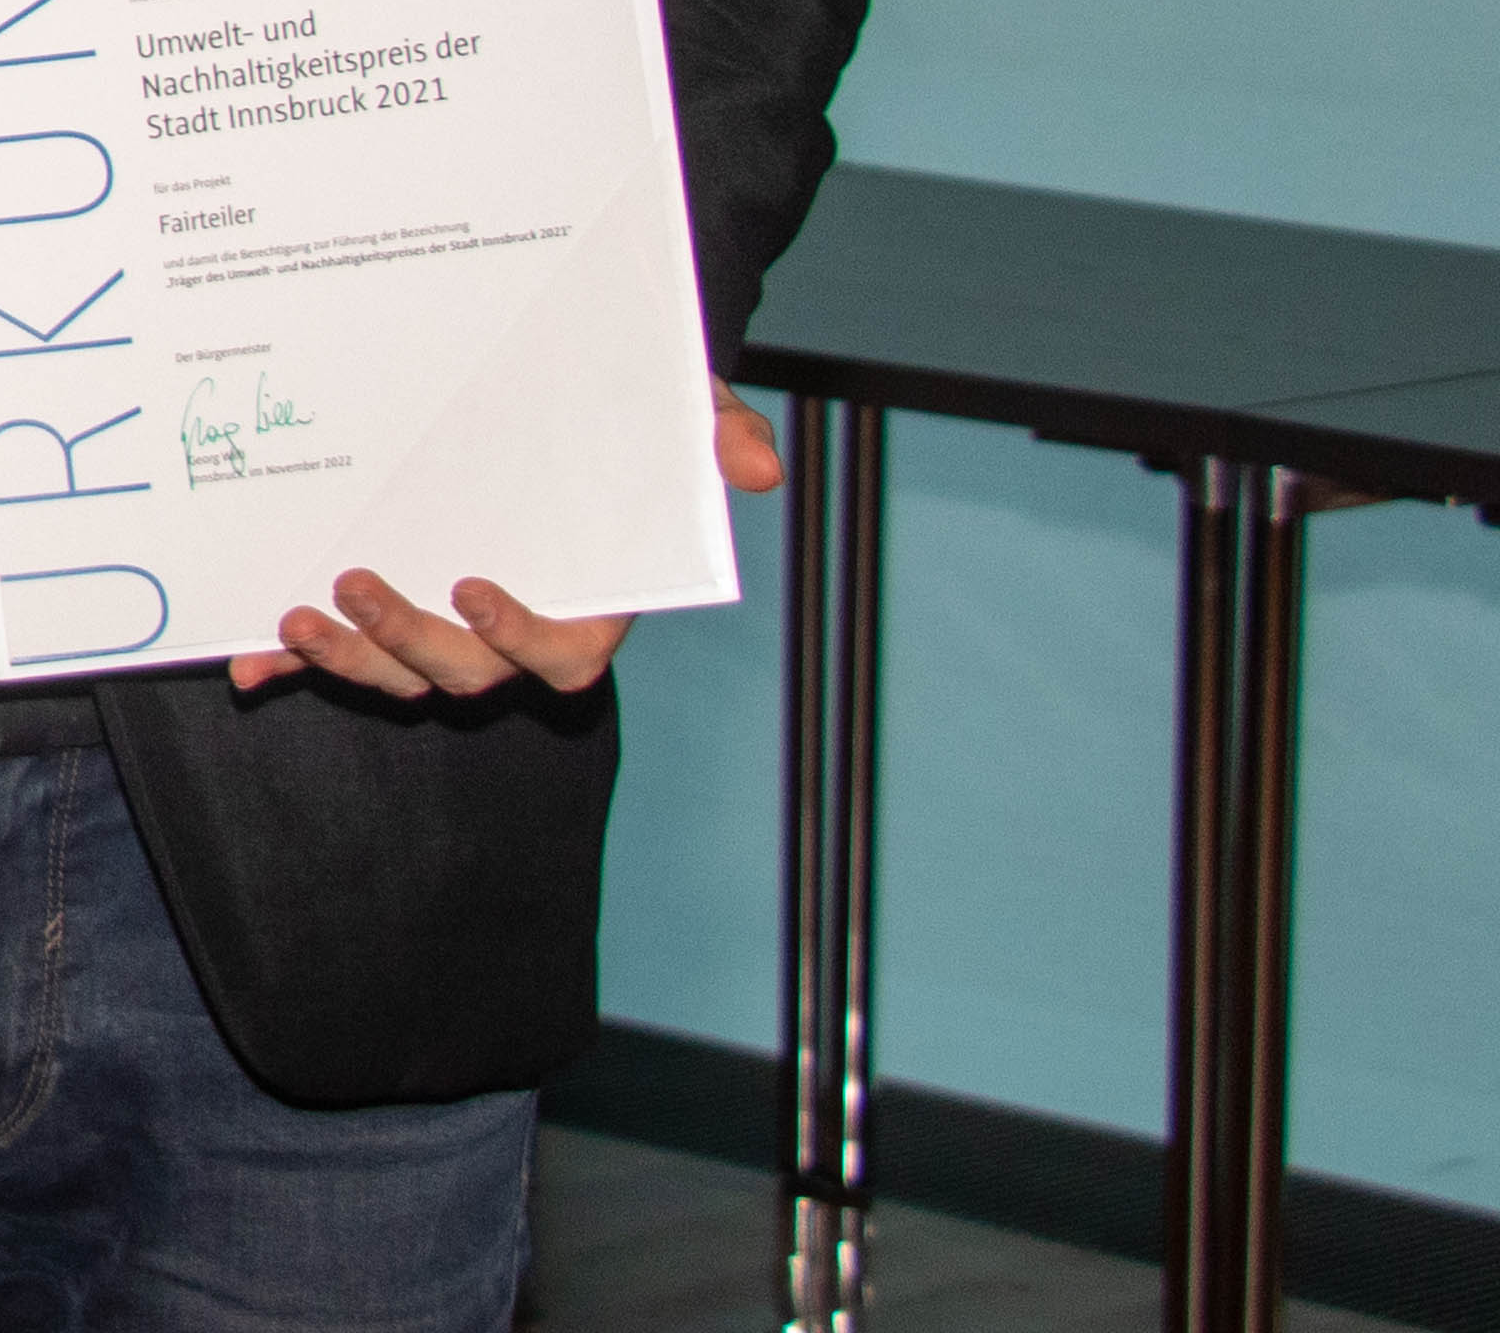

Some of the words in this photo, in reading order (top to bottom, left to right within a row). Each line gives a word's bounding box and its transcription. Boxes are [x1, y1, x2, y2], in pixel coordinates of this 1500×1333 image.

[136, 20, 253, 59] Umwelt-
[263, 9, 317, 42] und
[142, 38, 428, 99] Nachhaltigkeitspreis
[435, 31, 480, 59] der
[146, 106, 221, 140] Stadt
[228, 85, 367, 129] Innsbruck
[376, 77, 448, 109] 2021
[153, 183, 170, 194] für
[171, 181, 191, 193] das
[193, 175, 231, 190] Projekt
[158, 204, 256, 235] Fairteiler
[163, 257, 185, 270] und
[186, 253, 218, 267] damit
[220, 252, 238, 262] die
[239, 243, 312, 260] Berechtigung
[313, 240, 330, 251] zur
[332, 234, 379, 247] Führung
[379, 231, 398, 242] der
[399, 221, 471, 240] Bezeichnung
[205, 273, 225, 283] des
[277, 261, 299, 274] und
[300, 246, 427, 270] Nachhaltigkeitspreises
[427, 243, 447, 254] der
[449, 238, 480, 251] Stadt
[481, 229, 537, 247] Innsbruck
[175, 353, 194, 364] Der
[196, 343, 272, 362] Bürgermeister
[266, 461, 320, 476] November
[324, 455, 353, 470] 2022
